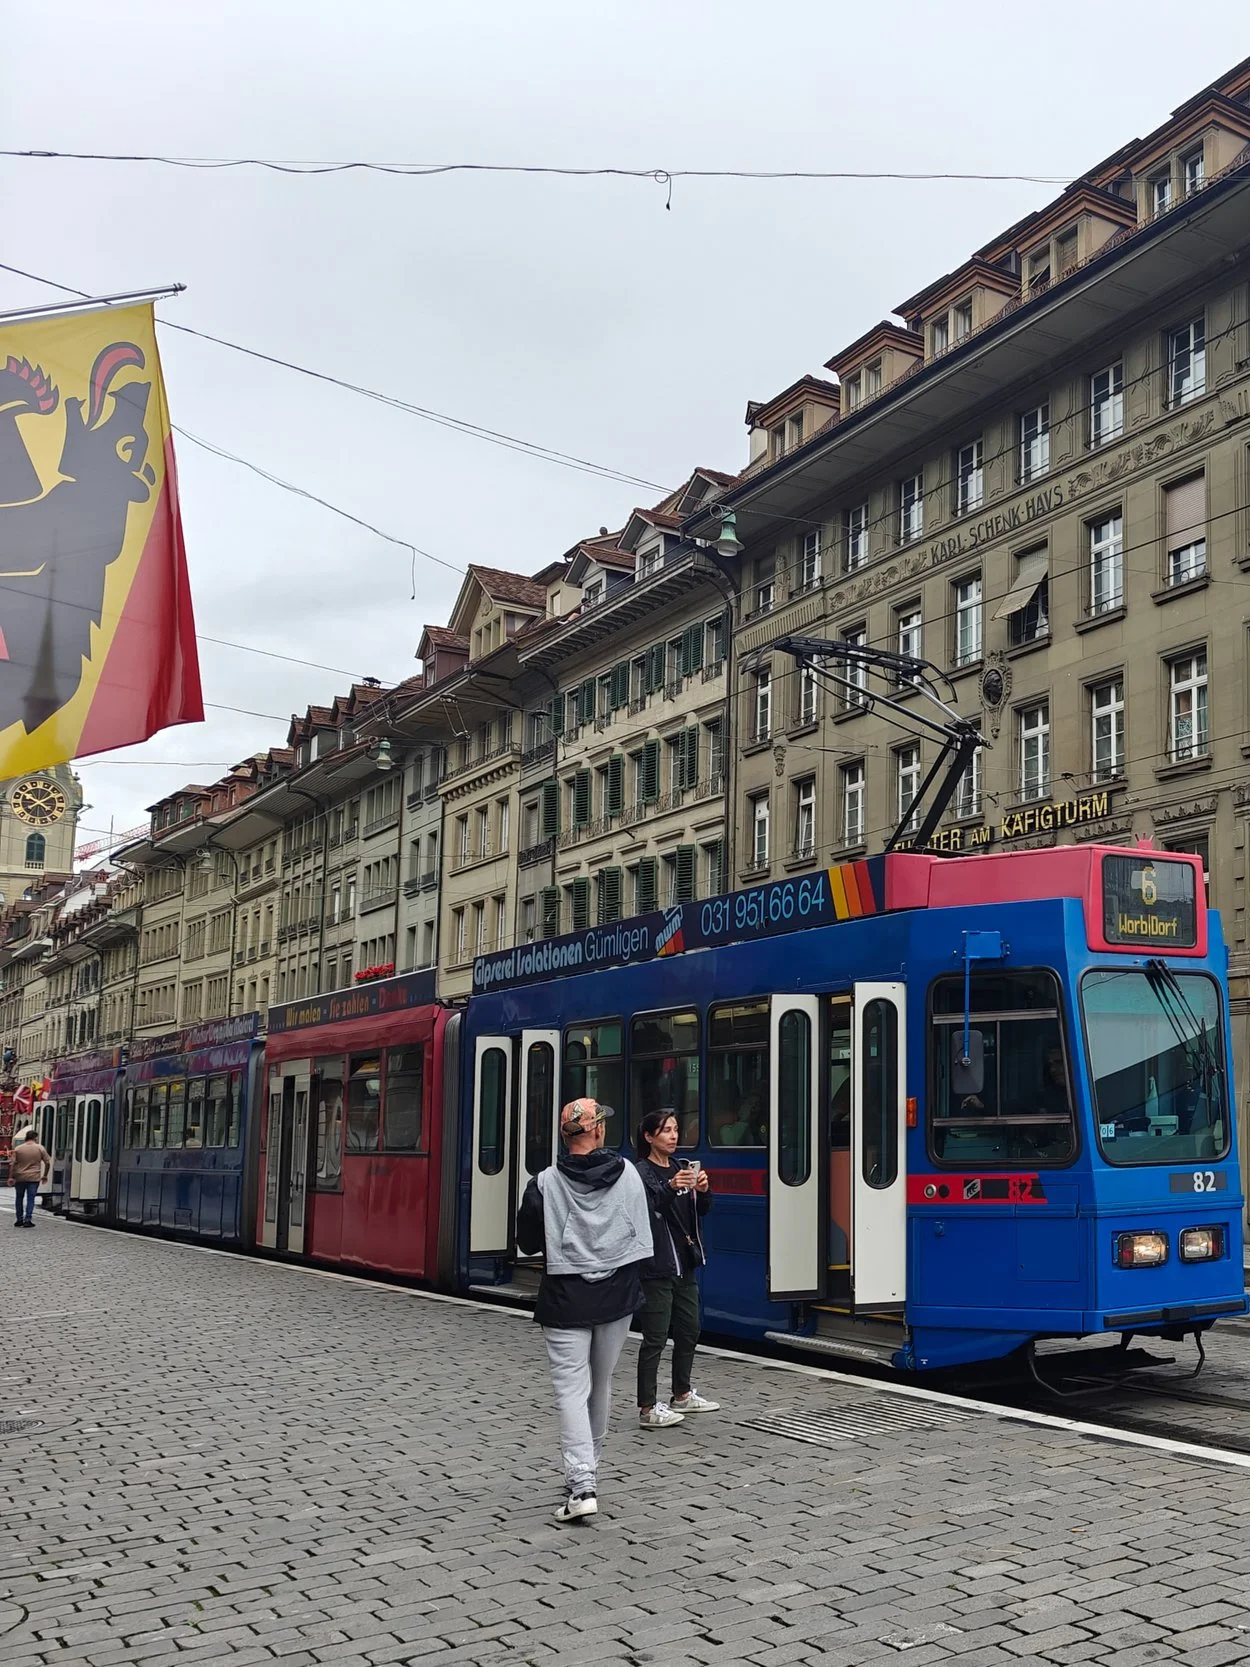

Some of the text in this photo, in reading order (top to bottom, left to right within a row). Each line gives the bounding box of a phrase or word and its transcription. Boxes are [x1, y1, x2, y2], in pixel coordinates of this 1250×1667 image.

[931, 533, 965, 564] KARL
[969, 504, 1021, 547] SCHENK
[970, 826, 990, 846] AM
[1001, 792, 1109, 838] KÄFIGTURM
[701, 876, 824, 936] 031 951 66 64
[1141, 866, 1157, 905] 6
[474, 925, 648, 990] Gipserei Isolationen Gümligen
[1008, 1178, 1033, 1200] 82
[1193, 1171, 1216, 1193] 82
